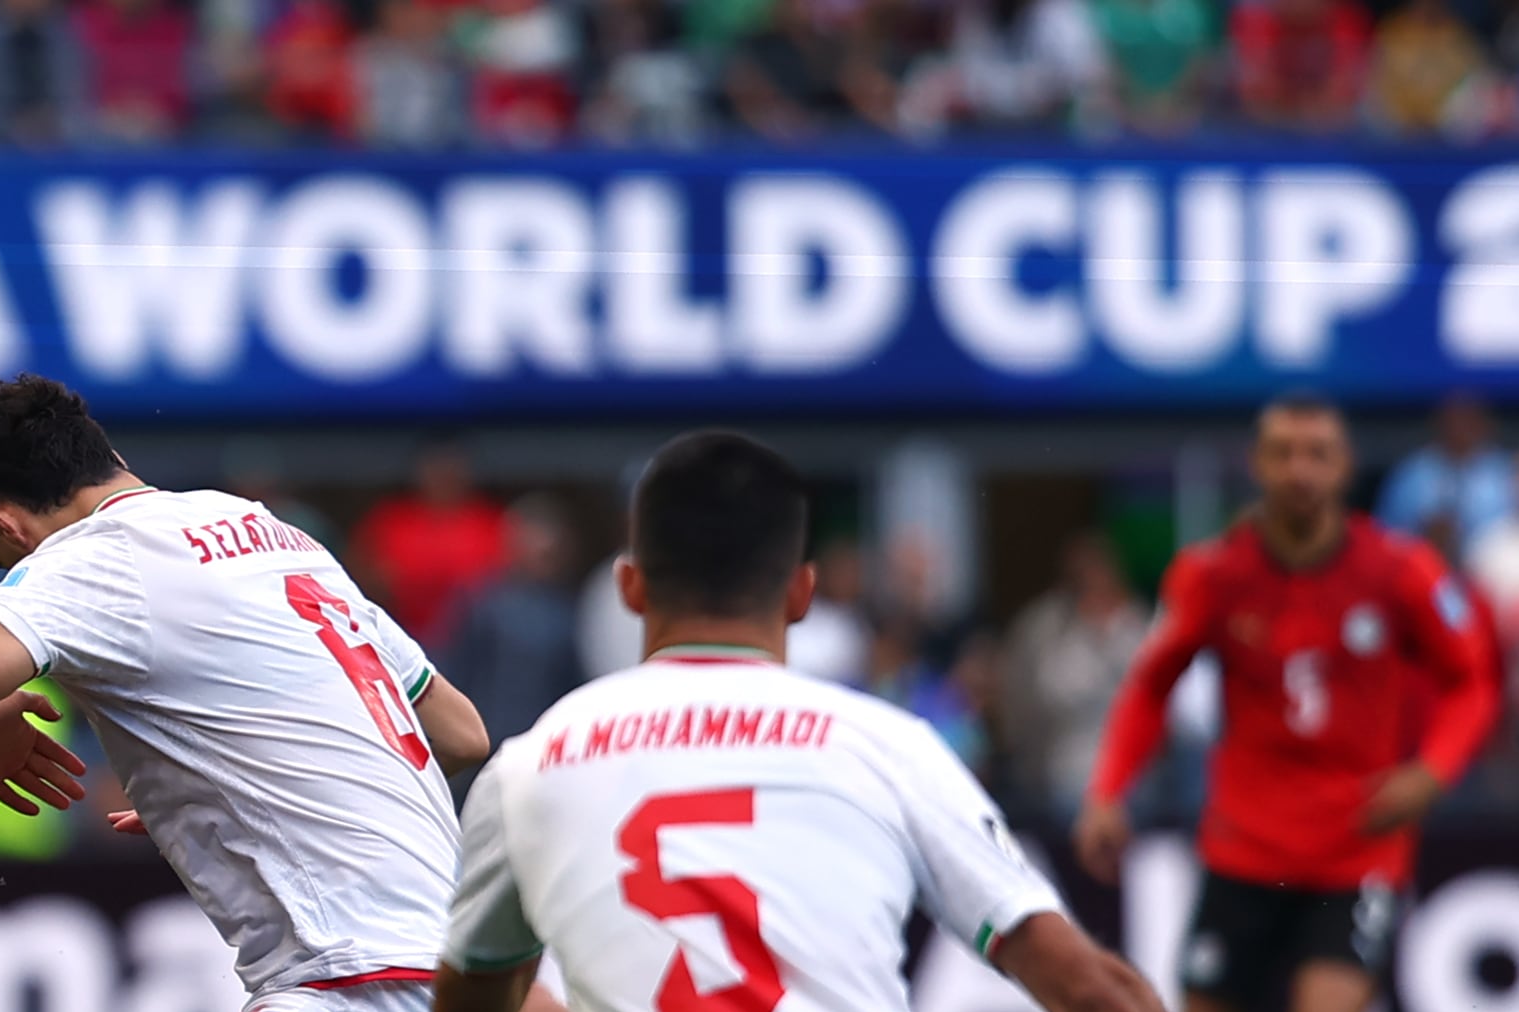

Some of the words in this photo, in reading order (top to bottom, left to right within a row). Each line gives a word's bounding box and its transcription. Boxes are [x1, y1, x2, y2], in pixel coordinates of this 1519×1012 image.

[36, 172, 912, 382] WORLD
[928, 164, 1418, 378] CUP
[283, 573, 430, 771] 6
[536, 704, 834, 774] M.MOHAMMADI
